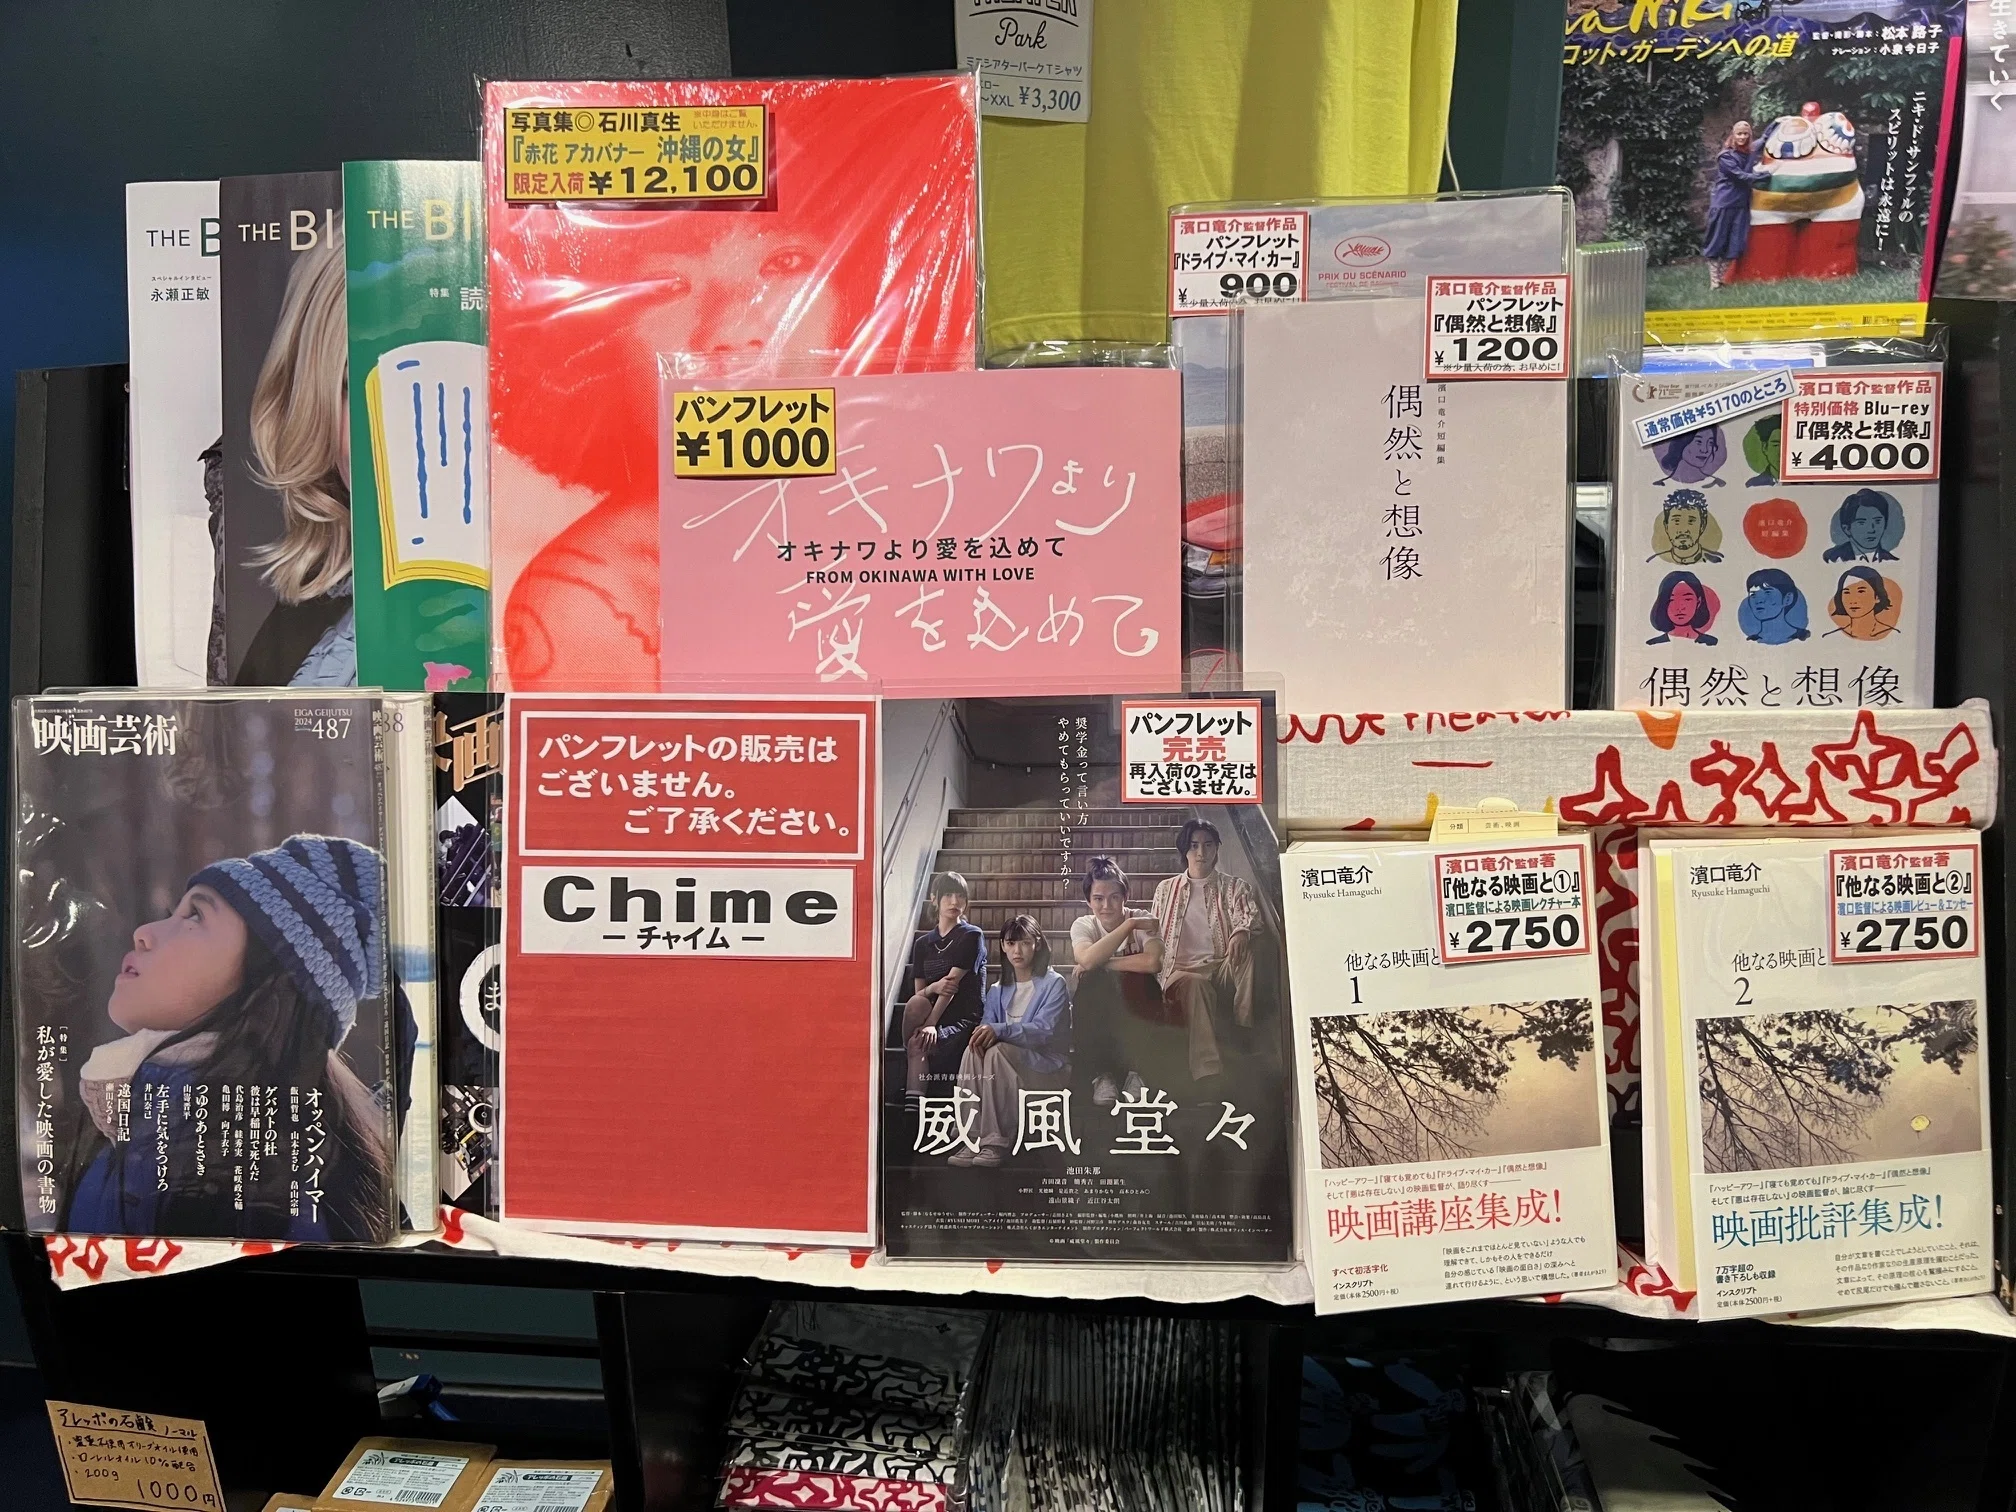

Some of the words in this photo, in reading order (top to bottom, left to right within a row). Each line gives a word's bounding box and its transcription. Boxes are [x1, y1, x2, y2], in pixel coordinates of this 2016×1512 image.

[995, 17, 1048, 49] Park
[1019, 86, 1081, 113] ¥3,300
[657, 134, 759, 164] 沖縄の女』
[1898, 91, 1927, 222] ニキ・ド・サンファルの
[513, 171, 584, 195] 限定入荷
[588, 164, 758, 195] ¥12,100
[238, 222, 282, 242] THE
[289, 208, 334, 251] BI
[367, 209, 415, 229] THE
[1180, 218, 1297, 235] 濱口竜介監督作品
[146, 229, 191, 247] THE
[1206, 233, 1299, 250] パンフレット
[1173, 251, 1300, 271] 『ドライブ・マイ・カー』
[1318, 272, 1340, 281] PRIX
[1343, 272, 1356, 280] DU
[1435, 281, 1557, 297] 濱口竜介監督作品
[150, 287, 210, 302] 永瀬正敏
[429, 287, 450, 298] 特集
[1466, 297, 1564, 312] パンフレット
[1434, 314, 1557, 333] 『偶然と想像』
[1799, 380, 1932, 396] 濱口竜介監督作品
[675, 392, 830, 424] パンフレット
[1794, 401, 1859, 416] 特別価格
[1864, 401, 1930, 416] Blu-rey
[1796, 419, 1931, 440] 『偶然と想像』
[676, 427, 830, 468] ¥1000
[1379, 384, 1423, 581] 偶然と想像
[776, 535, 1067, 563] オキナワより愛を込めて
[806, 570, 854, 584] FROM
[859, 568, 938, 584] OKINAWA
[943, 568, 987, 583] WITH
[993, 566, 1035, 582] LOVE
[1638, 664, 1904, 707] 偶然と想像
[294, 709, 313, 717] EIGA
[315, 708, 353, 718] GEIJUTSU
[1130, 711, 1252, 735] パンフレット
[33, 714, 178, 756] 映画芸術
[294, 718, 312, 726] 2024
[312, 718, 351, 739] 487
[435, 700, 504, 792] 画
[538, 733, 838, 763] パンフレットの販売は
[1162, 735, 1227, 762] 完売
[537, 769, 736, 799] ございません。
[1075, 716, 1089, 826] 奨学金って言い方
[1129, 762, 1257, 780] 再入荷の予定は
[1140, 779, 1251, 796] ございません。
[1058, 717, 1072, 890] やめてもらっていいですか?
[624, 805, 851, 837] ご了承ください。
[1446, 853, 1556, 875] 濱口竜介監督著
[1690, 862, 1762, 886] 濱口竜介
[1840, 852, 1951, 871] 濱口竜介監督著
[1301, 865, 1374, 888] 濱口竜介
[543, 875, 838, 925] Chime
[1302, 889, 1336, 900] Ryusuke
[1337, 886, 1382, 899] Hamaguchi
[1691, 887, 1724, 899] Ryusuke
[1725, 884, 1770, 897] Hamaguchi
[1344, 948, 1440, 972] 他なる映画と
[1732, 947, 1827, 973] 他なる映画と
[1350, 975, 1363, 1004] 1
[1734, 977, 1753, 1006] 2
[36, 1025, 57, 1214] 私が愛した映画の書物
[195, 1084, 209, 1176] つゆのあとさき
[263, 1086, 279, 1157] ゲバルトの杜
[912, 1085, 1256, 1156] 威風堂々
[155, 1084, 170, 1192] 左手に気をつけろ
[249, 1085, 261, 1181] 彼は早稲田で死んだ
[304, 1087, 326, 1224] オッペンハイマー
[1066, 1166, 1101, 1175] 池田朱那
[1327, 1188, 1562, 1244] 映画講座集成!
[1712, 1193, 1943, 1250] 映画批評集成!
[1332, 1263, 1389, 1277] すべて初活字化
[1716, 1270, 1776, 1284] 書き下ろしも収録
[1333, 1279, 1374, 1290] インスクリプト
[1716, 1286, 1757, 1297] インスクリプト
[137, 1479, 216, 1508] 1000円
